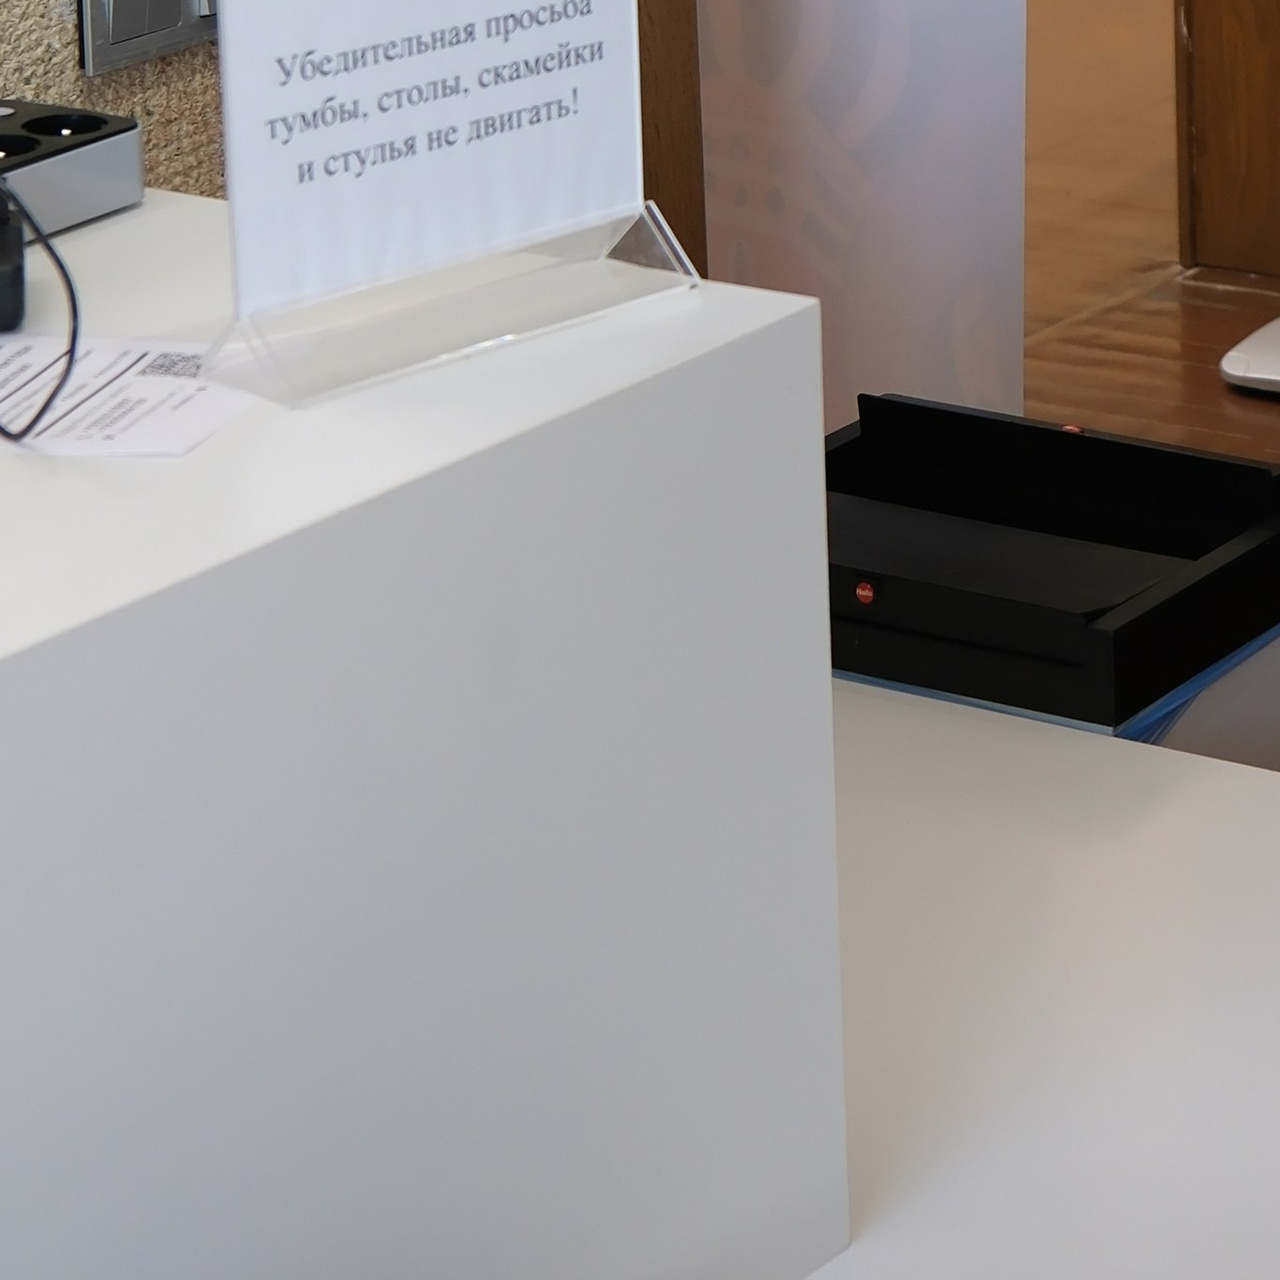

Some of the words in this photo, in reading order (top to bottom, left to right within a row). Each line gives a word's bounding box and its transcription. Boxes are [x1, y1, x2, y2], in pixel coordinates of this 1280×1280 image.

[264, 95, 370, 145] тумбы,
[376, 73, 470, 114] столы,
[477, 40, 605, 89] скамейки
[275, 20, 478, 87] Убедительная
[297, 159, 316, 185] и
[323, 136, 418, 179] стулья
[426, 124, 460, 152] не
[466, 86, 579, 145] двигать!
